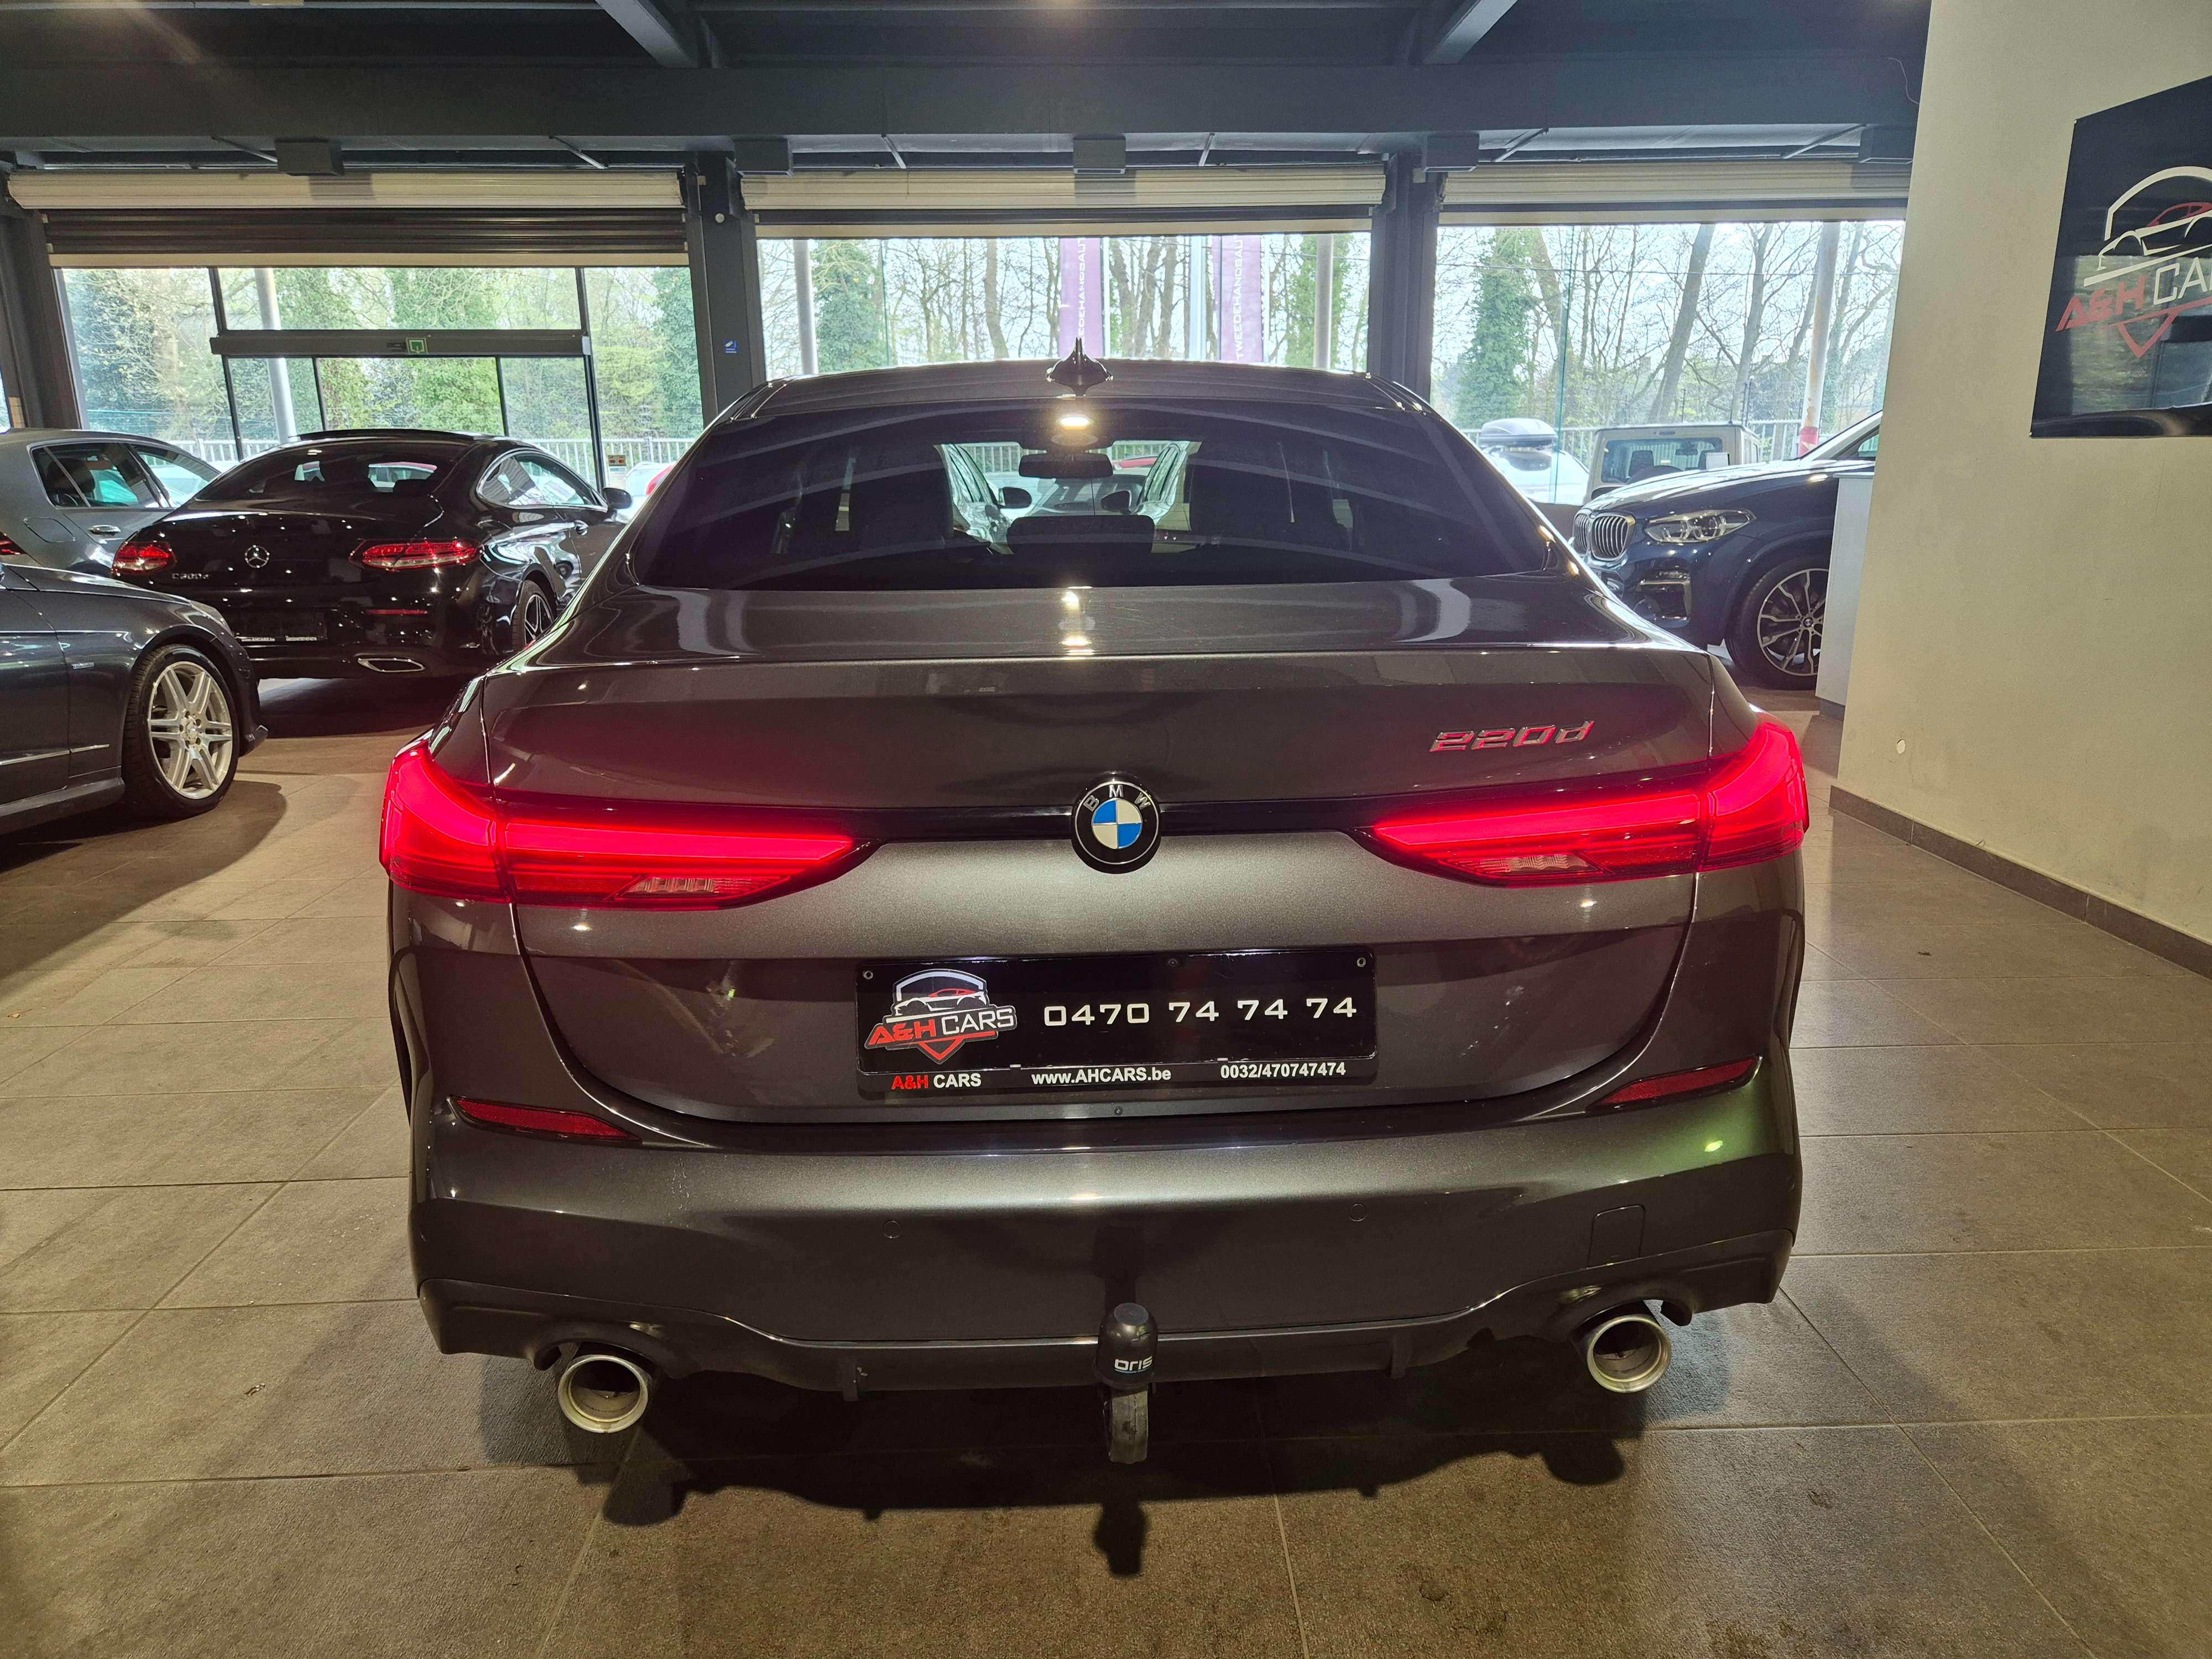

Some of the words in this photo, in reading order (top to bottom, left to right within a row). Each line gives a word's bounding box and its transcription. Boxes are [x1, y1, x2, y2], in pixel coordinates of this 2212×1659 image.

[2056, 274, 2146, 331] A&H
[2153, 257, 2212, 305] CA
[1430, 721, 1595, 752] 220d
[1083, 784, 1151, 812] BMW
[1044, 1003, 1150, 1026] 0470
[1168, 1001, 1219, 1022] 74
[1237, 999, 1288, 1020] 74
[1306, 997, 1357, 1018] 74
[868, 1019, 936, 1045] A&H
[941, 1008, 1014, 1036] CARS
[891, 1074, 929, 1090] A&H
[933, 1073, 982, 1089] CARS
[1031, 1066, 1172, 1084] www.AHCARS.be
[1220, 1062, 1346, 1079] 0032/470747474
